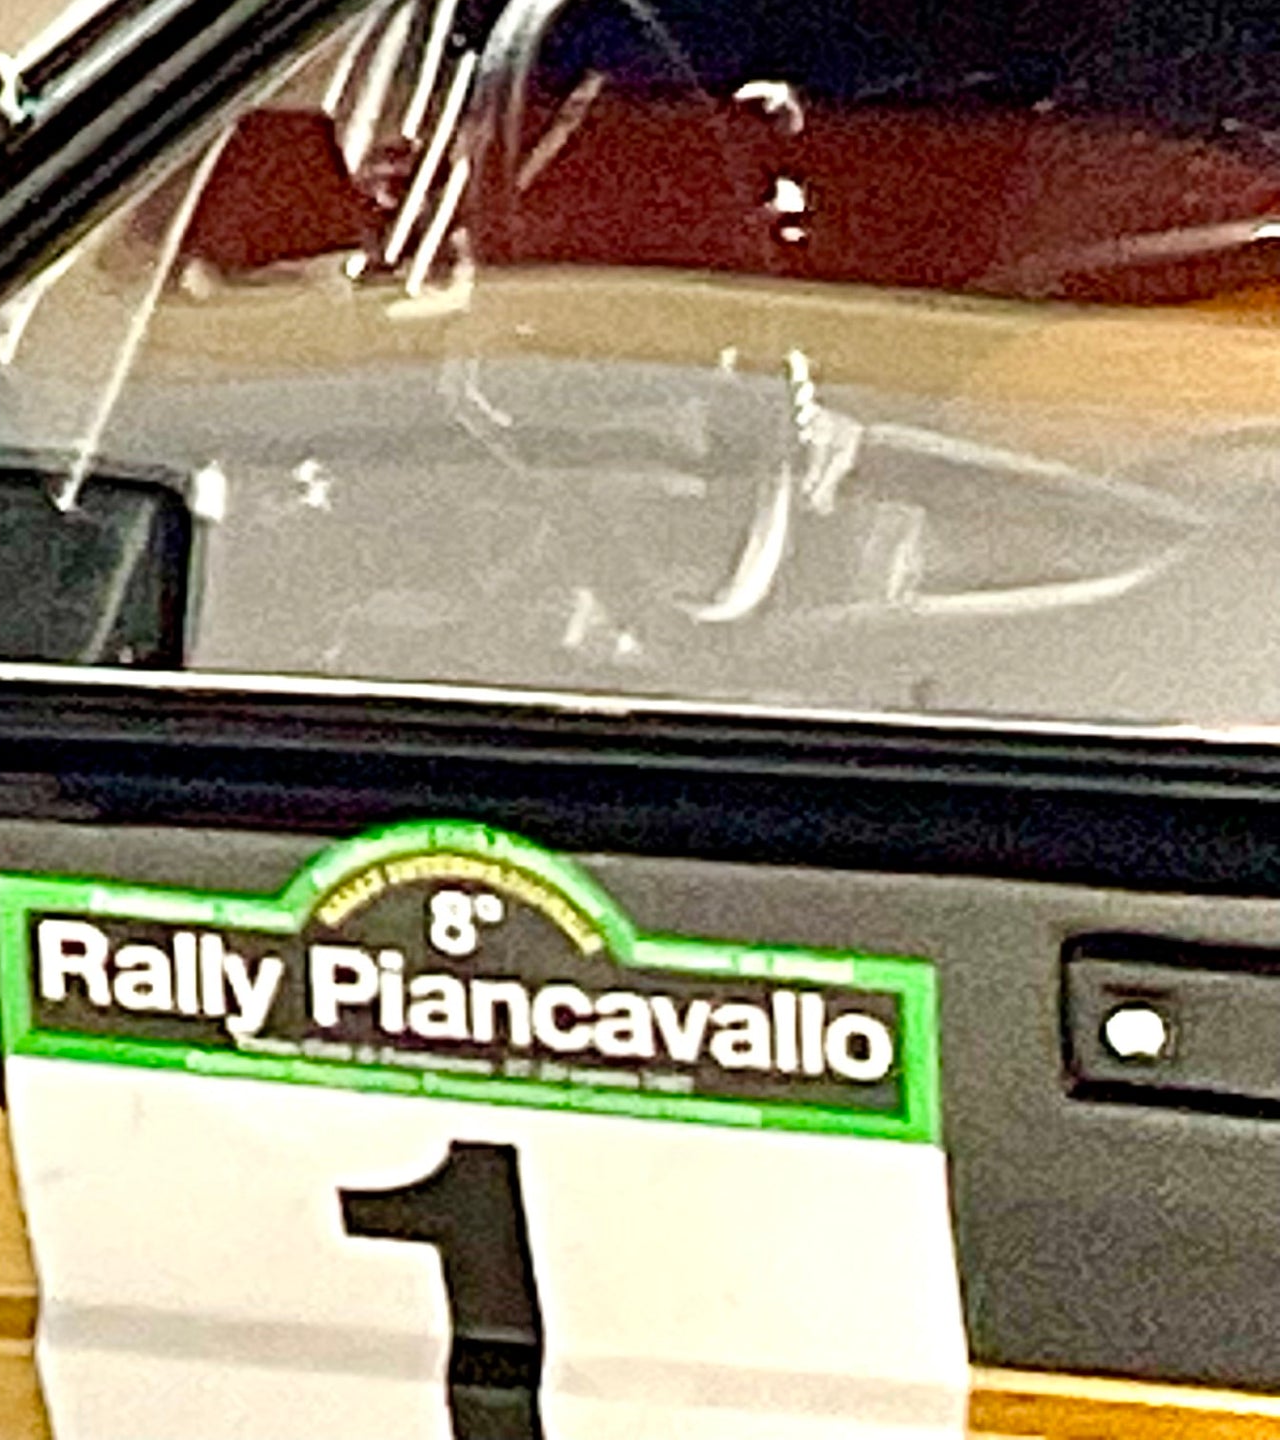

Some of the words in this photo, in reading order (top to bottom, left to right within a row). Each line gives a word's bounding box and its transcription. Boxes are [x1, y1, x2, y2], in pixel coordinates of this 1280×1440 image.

[37, 917, 284, 1037] Rally
[308, 942, 895, 1084] Piancavallo
[336, 1137, 547, 1440] 1
